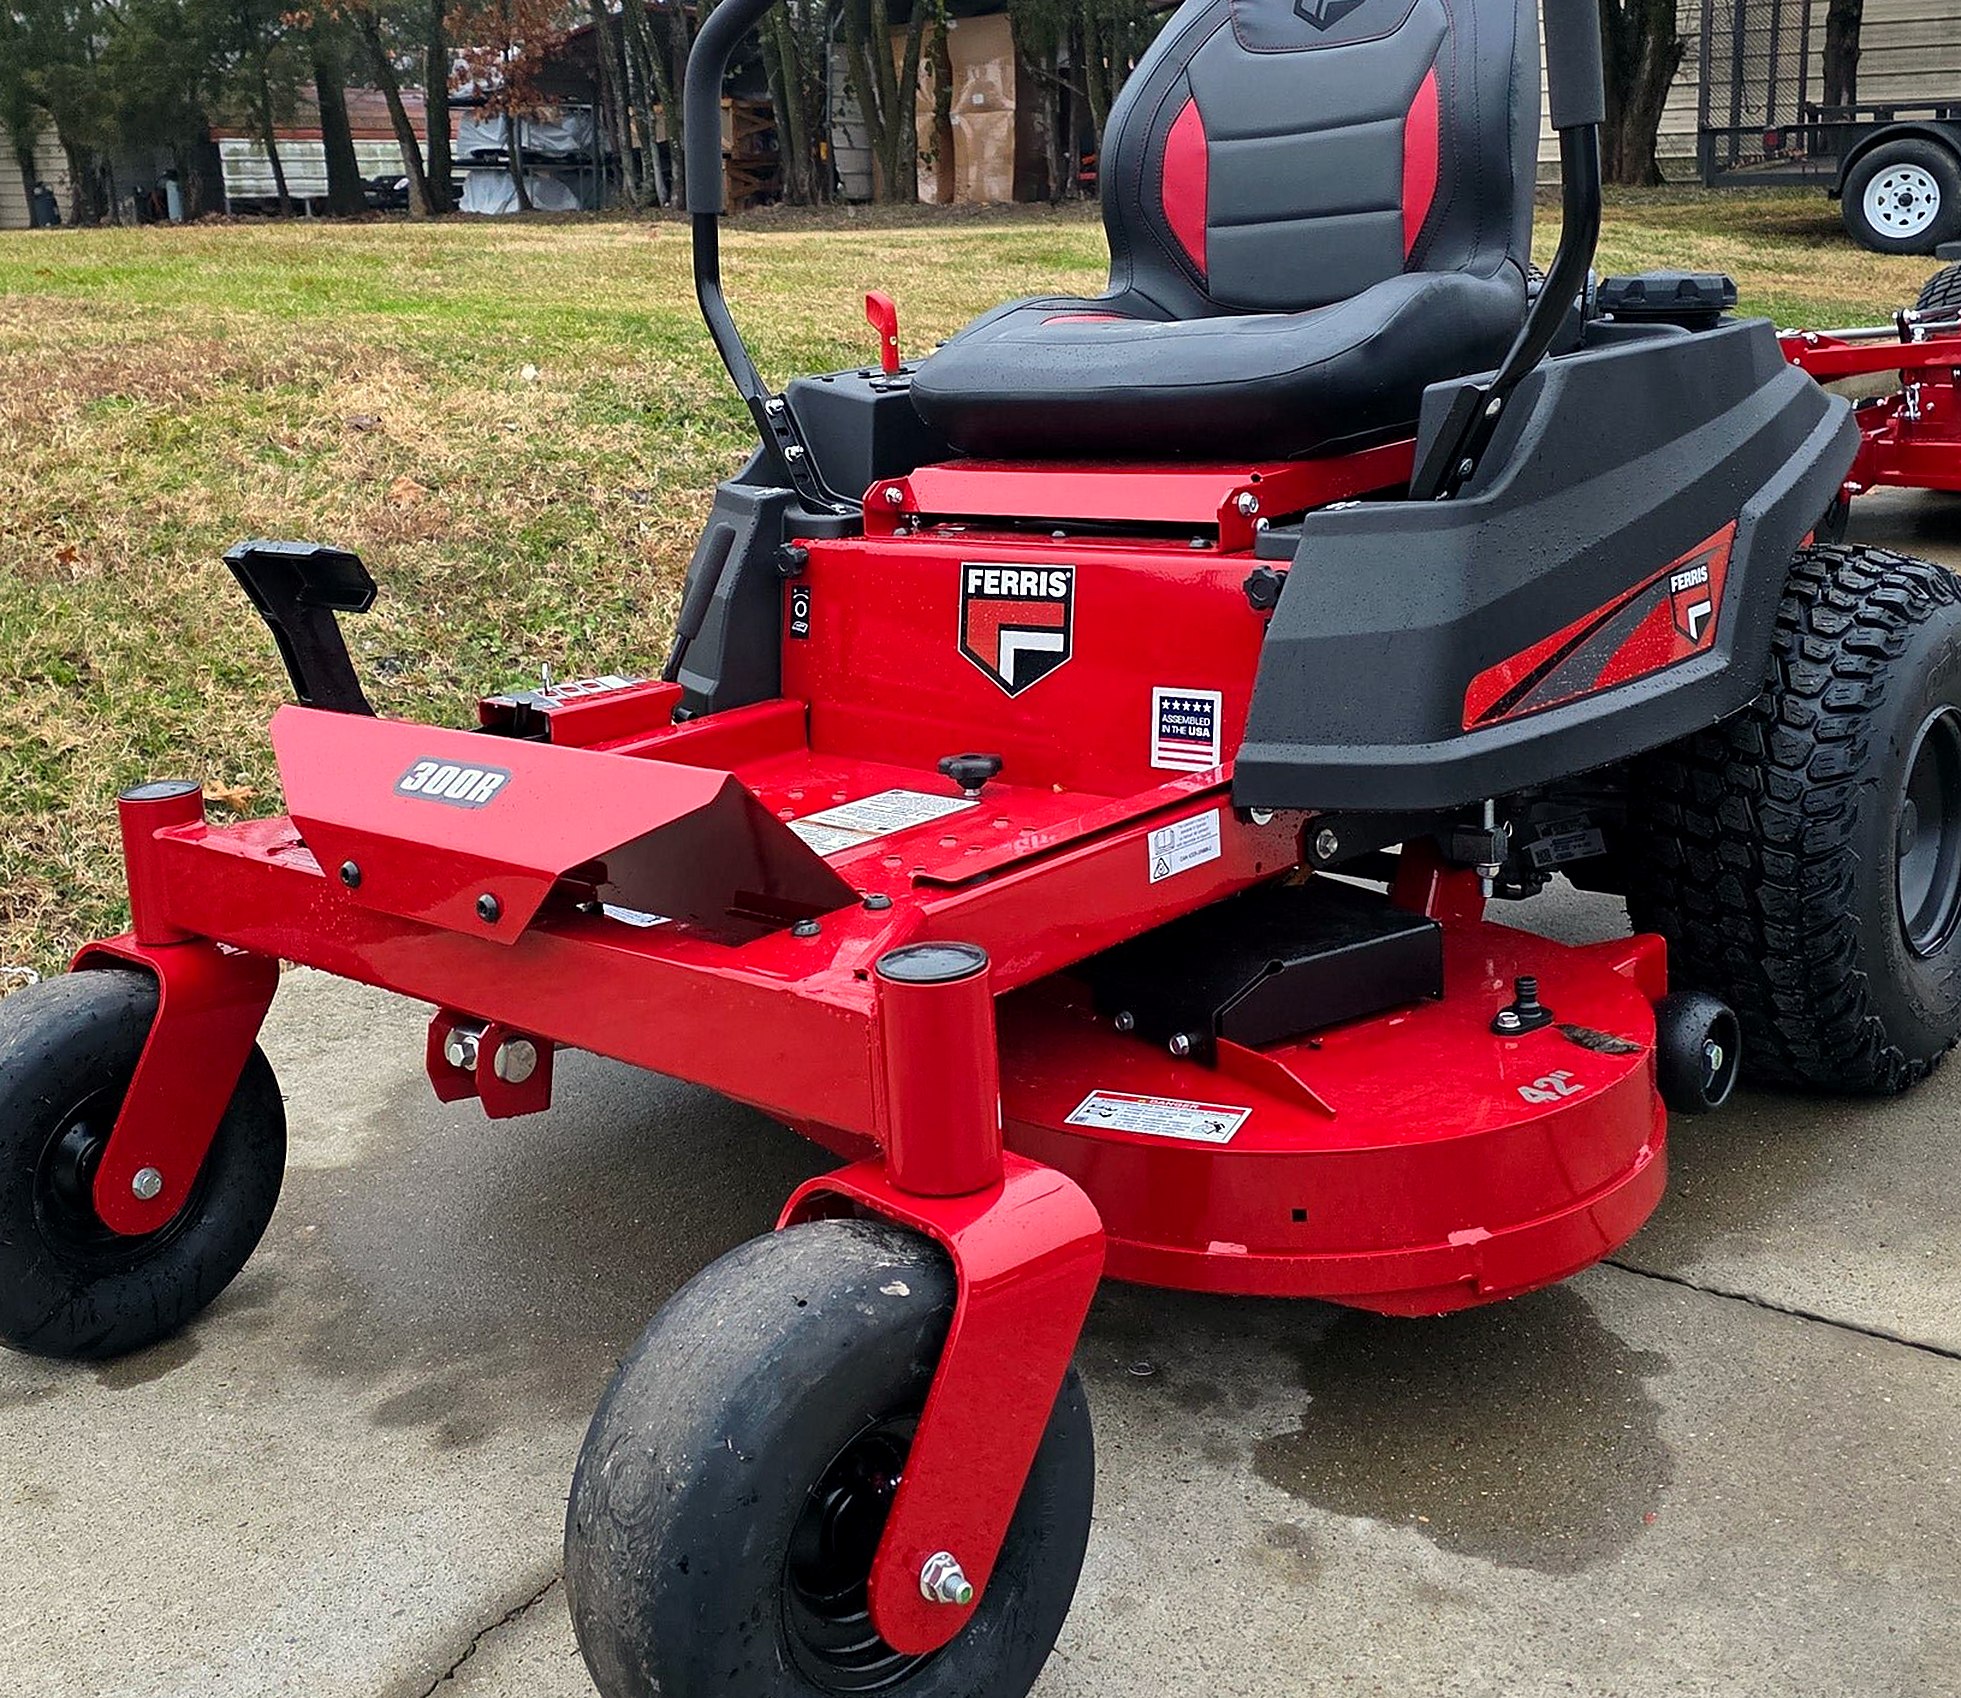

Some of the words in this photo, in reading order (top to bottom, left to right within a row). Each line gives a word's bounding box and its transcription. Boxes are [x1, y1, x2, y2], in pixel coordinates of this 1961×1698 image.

[967, 568, 1068, 598] FERRIS
[1670, 565, 1709, 593] FERRIS
[1161, 713, 1211, 727] ASSEMBLED
[1161, 724, 1171, 734] IN
[1172, 725, 1187, 735] THE
[1188, 726, 1211, 738] USA
[399, 761, 506, 803] 300R
